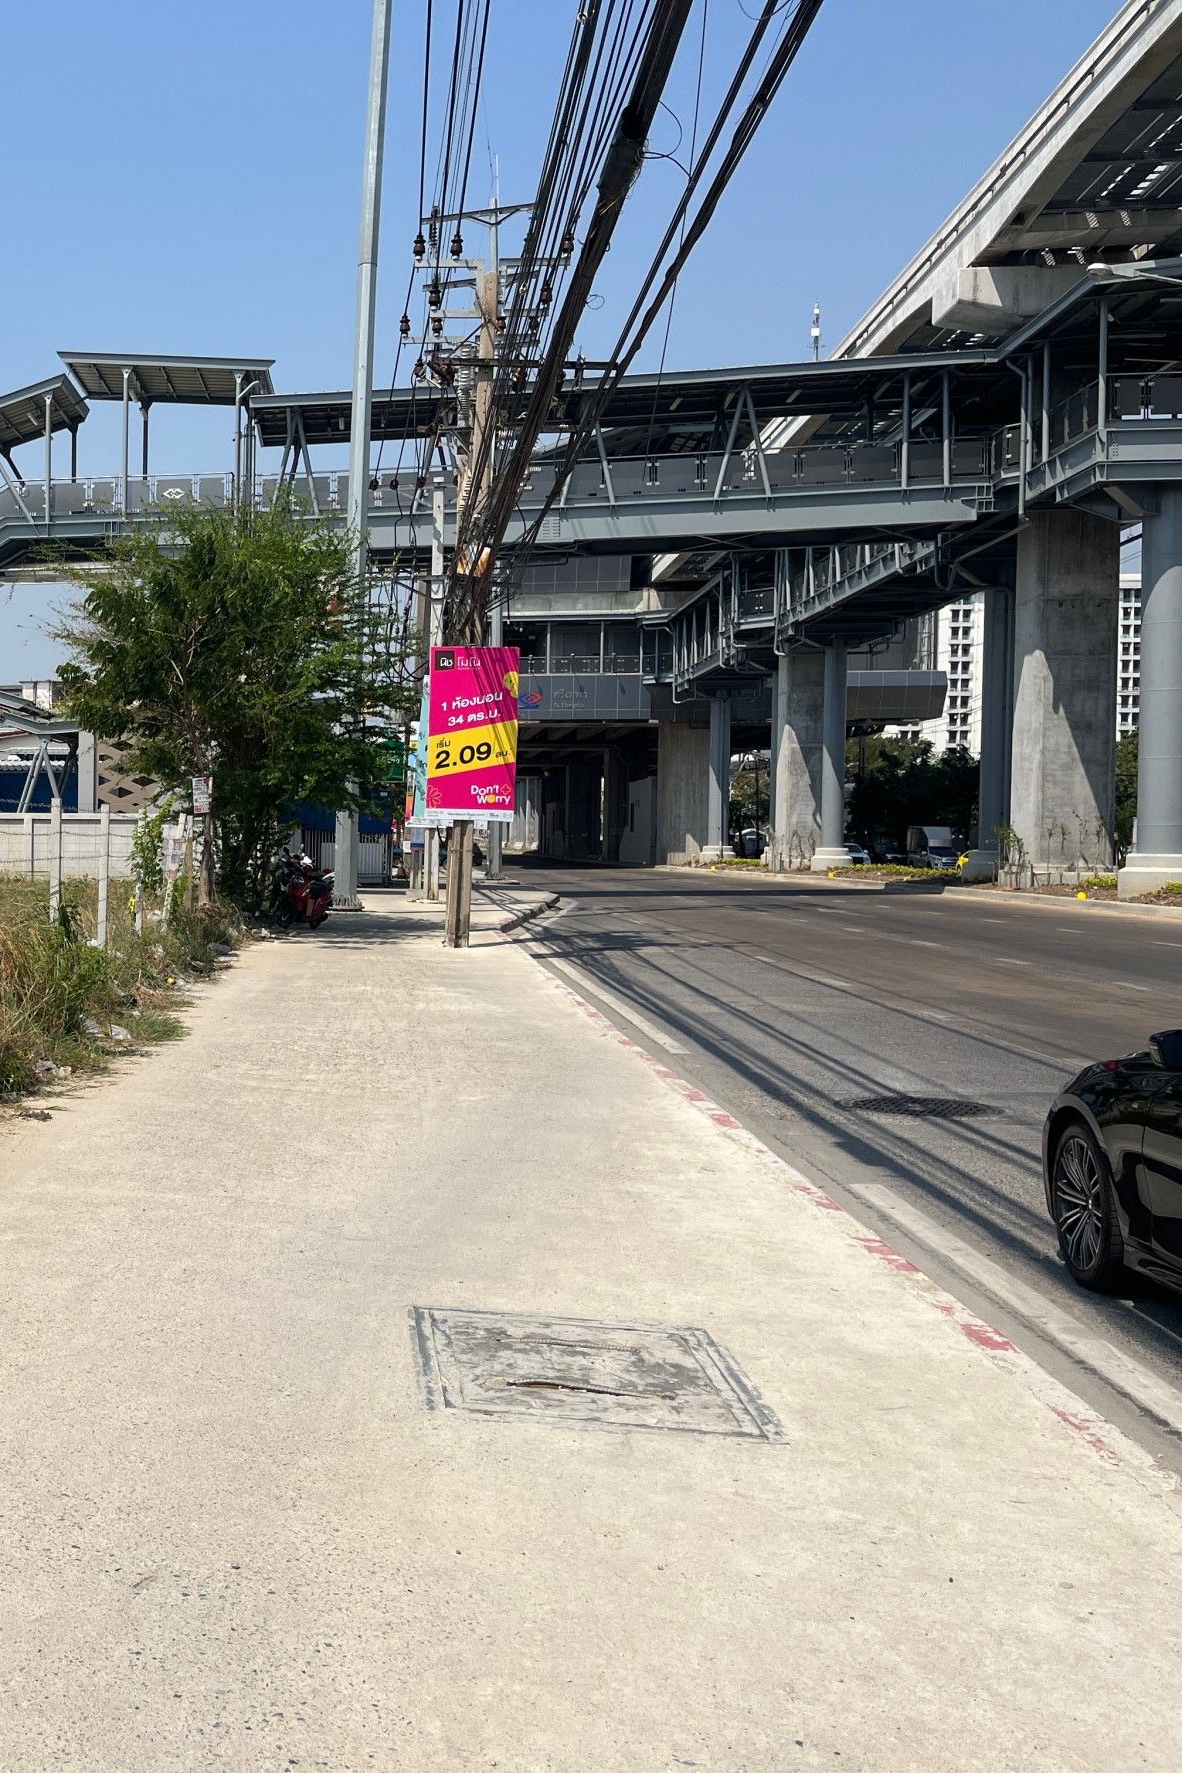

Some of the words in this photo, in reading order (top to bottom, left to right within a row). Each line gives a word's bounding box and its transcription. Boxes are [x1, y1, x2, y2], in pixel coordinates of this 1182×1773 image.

[440, 657, 453, 667] นิช
[457, 656, 481, 667] โมโน
[441, 702, 447, 711] 1
[452, 692, 503, 710] ห้องนอน
[447, 715, 464, 727] 34
[467, 709, 501, 723] ตร.ม.
[436, 737, 451, 749] เริ่ม
[435, 742, 492, 770] 2.09
[470, 785, 499, 796] Don't
[477, 794, 511, 805] Worry
